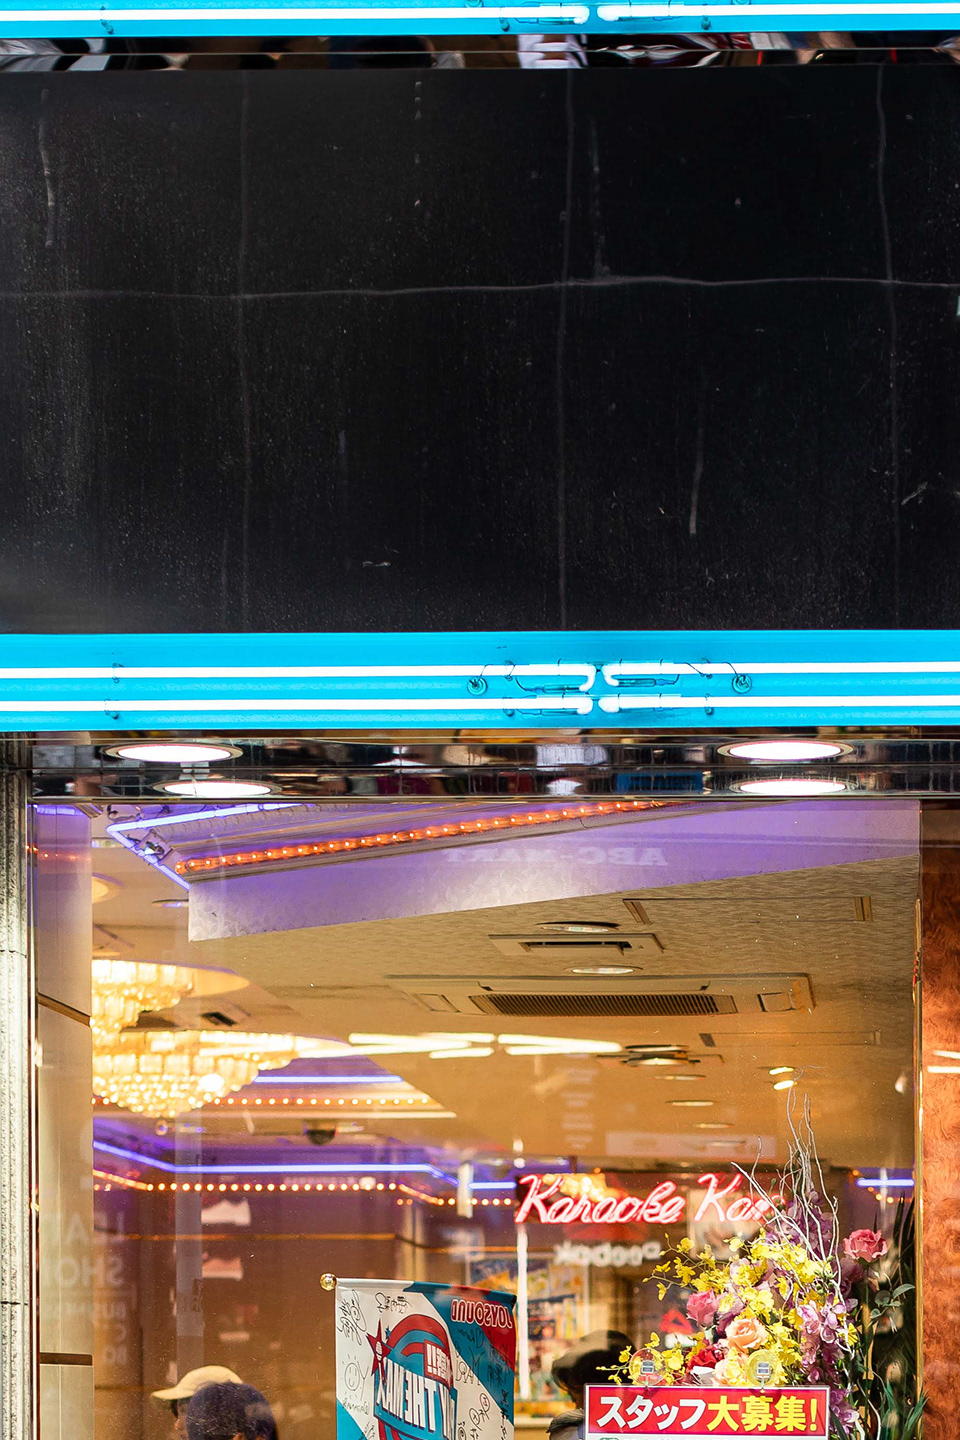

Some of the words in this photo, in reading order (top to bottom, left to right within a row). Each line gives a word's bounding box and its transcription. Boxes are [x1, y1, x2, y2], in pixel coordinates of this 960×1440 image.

[514, 1172, 686, 1224] Karaoke
[596, 1395, 818, 1432] スタッフ大募集!
